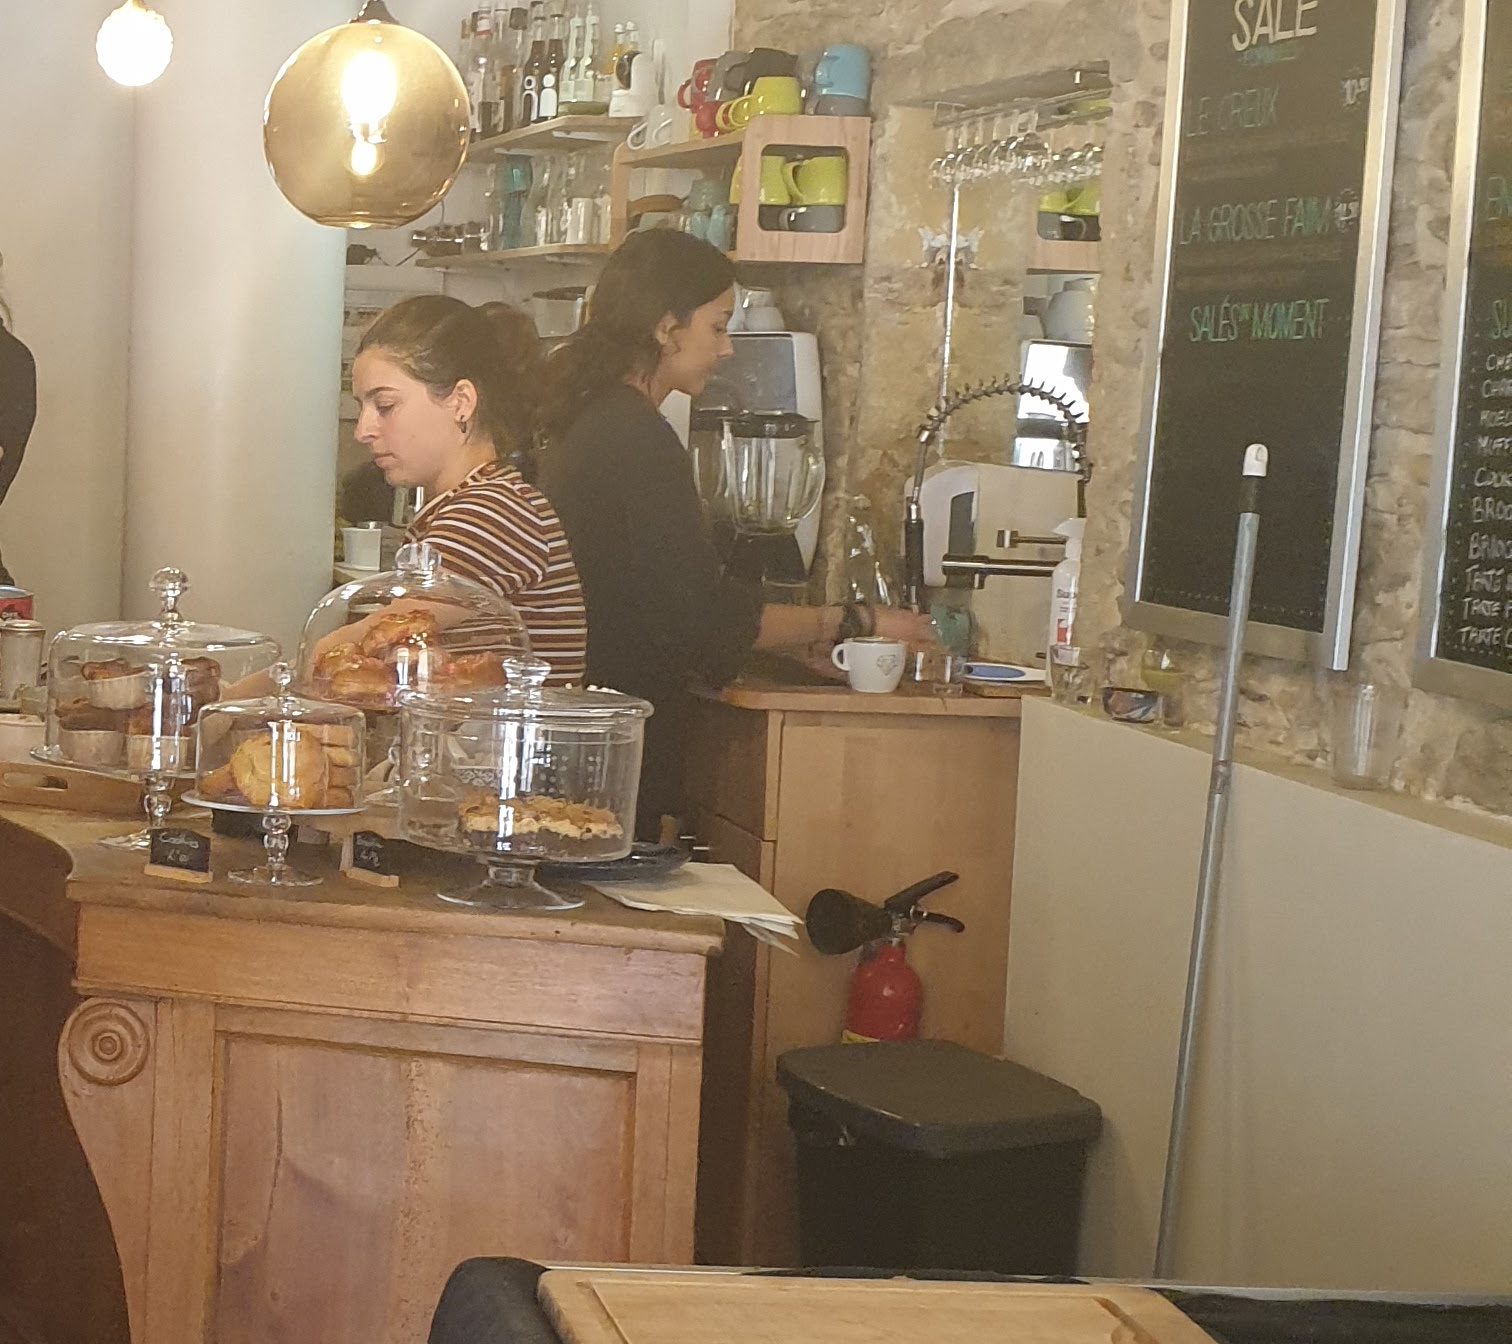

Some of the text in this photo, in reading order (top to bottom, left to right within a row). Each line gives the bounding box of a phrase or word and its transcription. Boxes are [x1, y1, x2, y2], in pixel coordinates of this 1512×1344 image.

[1179, 206, 1202, 245] LA
[1208, 199, 1278, 243] GROSSE
[1190, 295, 1238, 343] SALÉS
[1250, 299, 1329, 340] MOMENT
